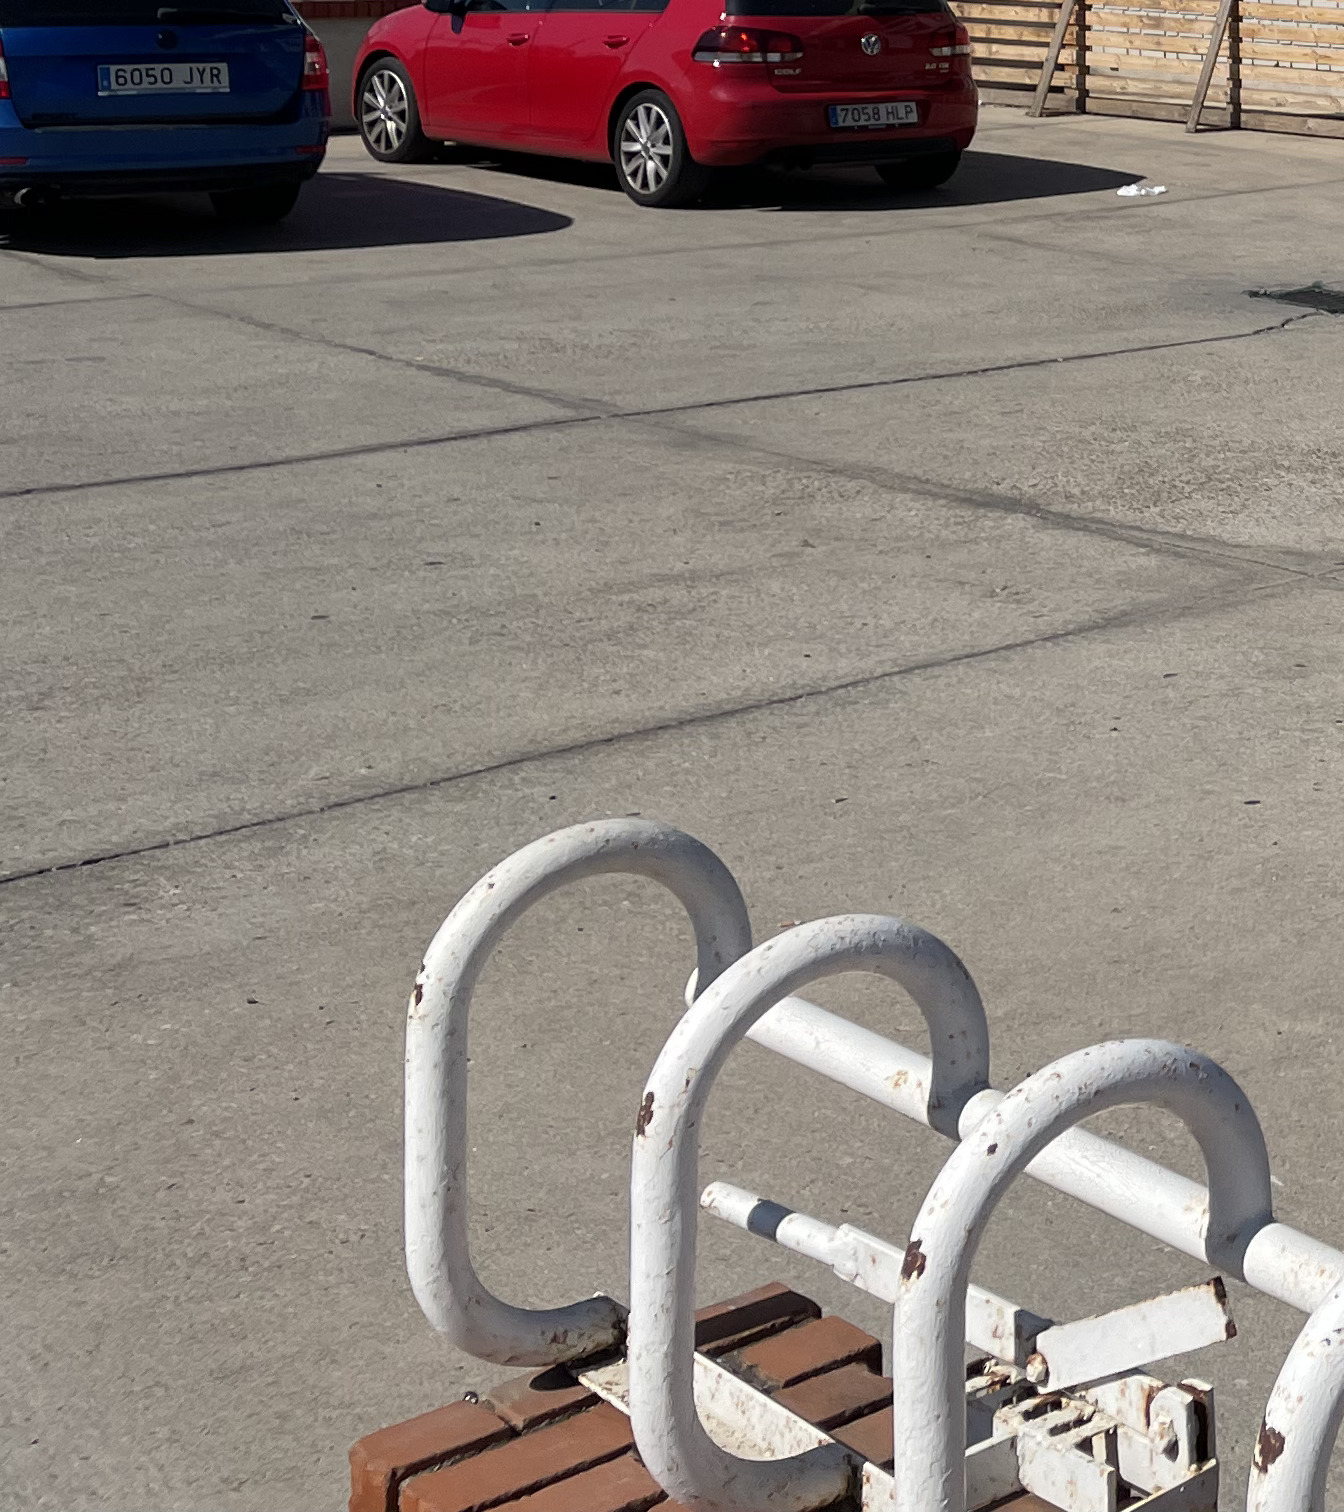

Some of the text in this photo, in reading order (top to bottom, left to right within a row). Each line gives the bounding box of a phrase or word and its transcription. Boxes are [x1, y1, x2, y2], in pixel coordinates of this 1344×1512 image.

[114, 66, 222, 86] 6050 JYR
[840, 104, 914, 123] 7058 HLP
